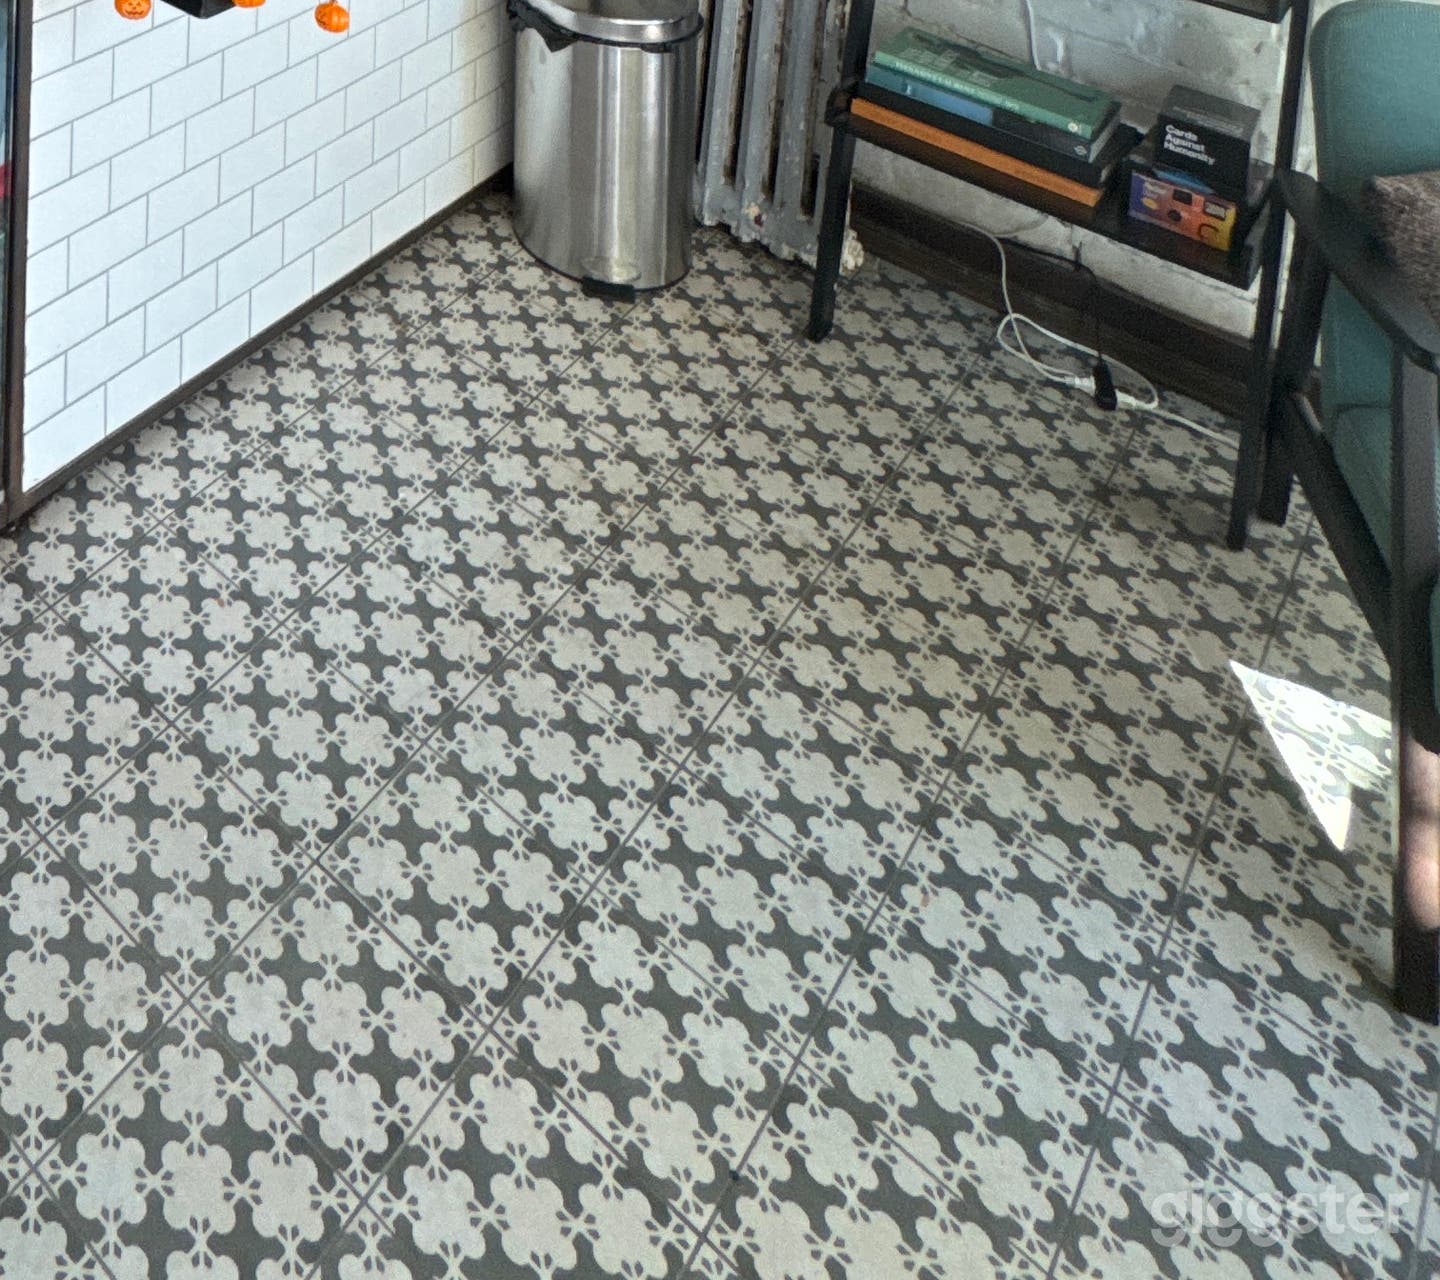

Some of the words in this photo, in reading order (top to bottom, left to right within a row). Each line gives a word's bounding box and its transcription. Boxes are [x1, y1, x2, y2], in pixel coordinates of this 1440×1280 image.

[1165, 124, 1198, 142] Cards
[1164, 134, 1205, 153] Against
[1163, 142, 1215, 166] Humanity
